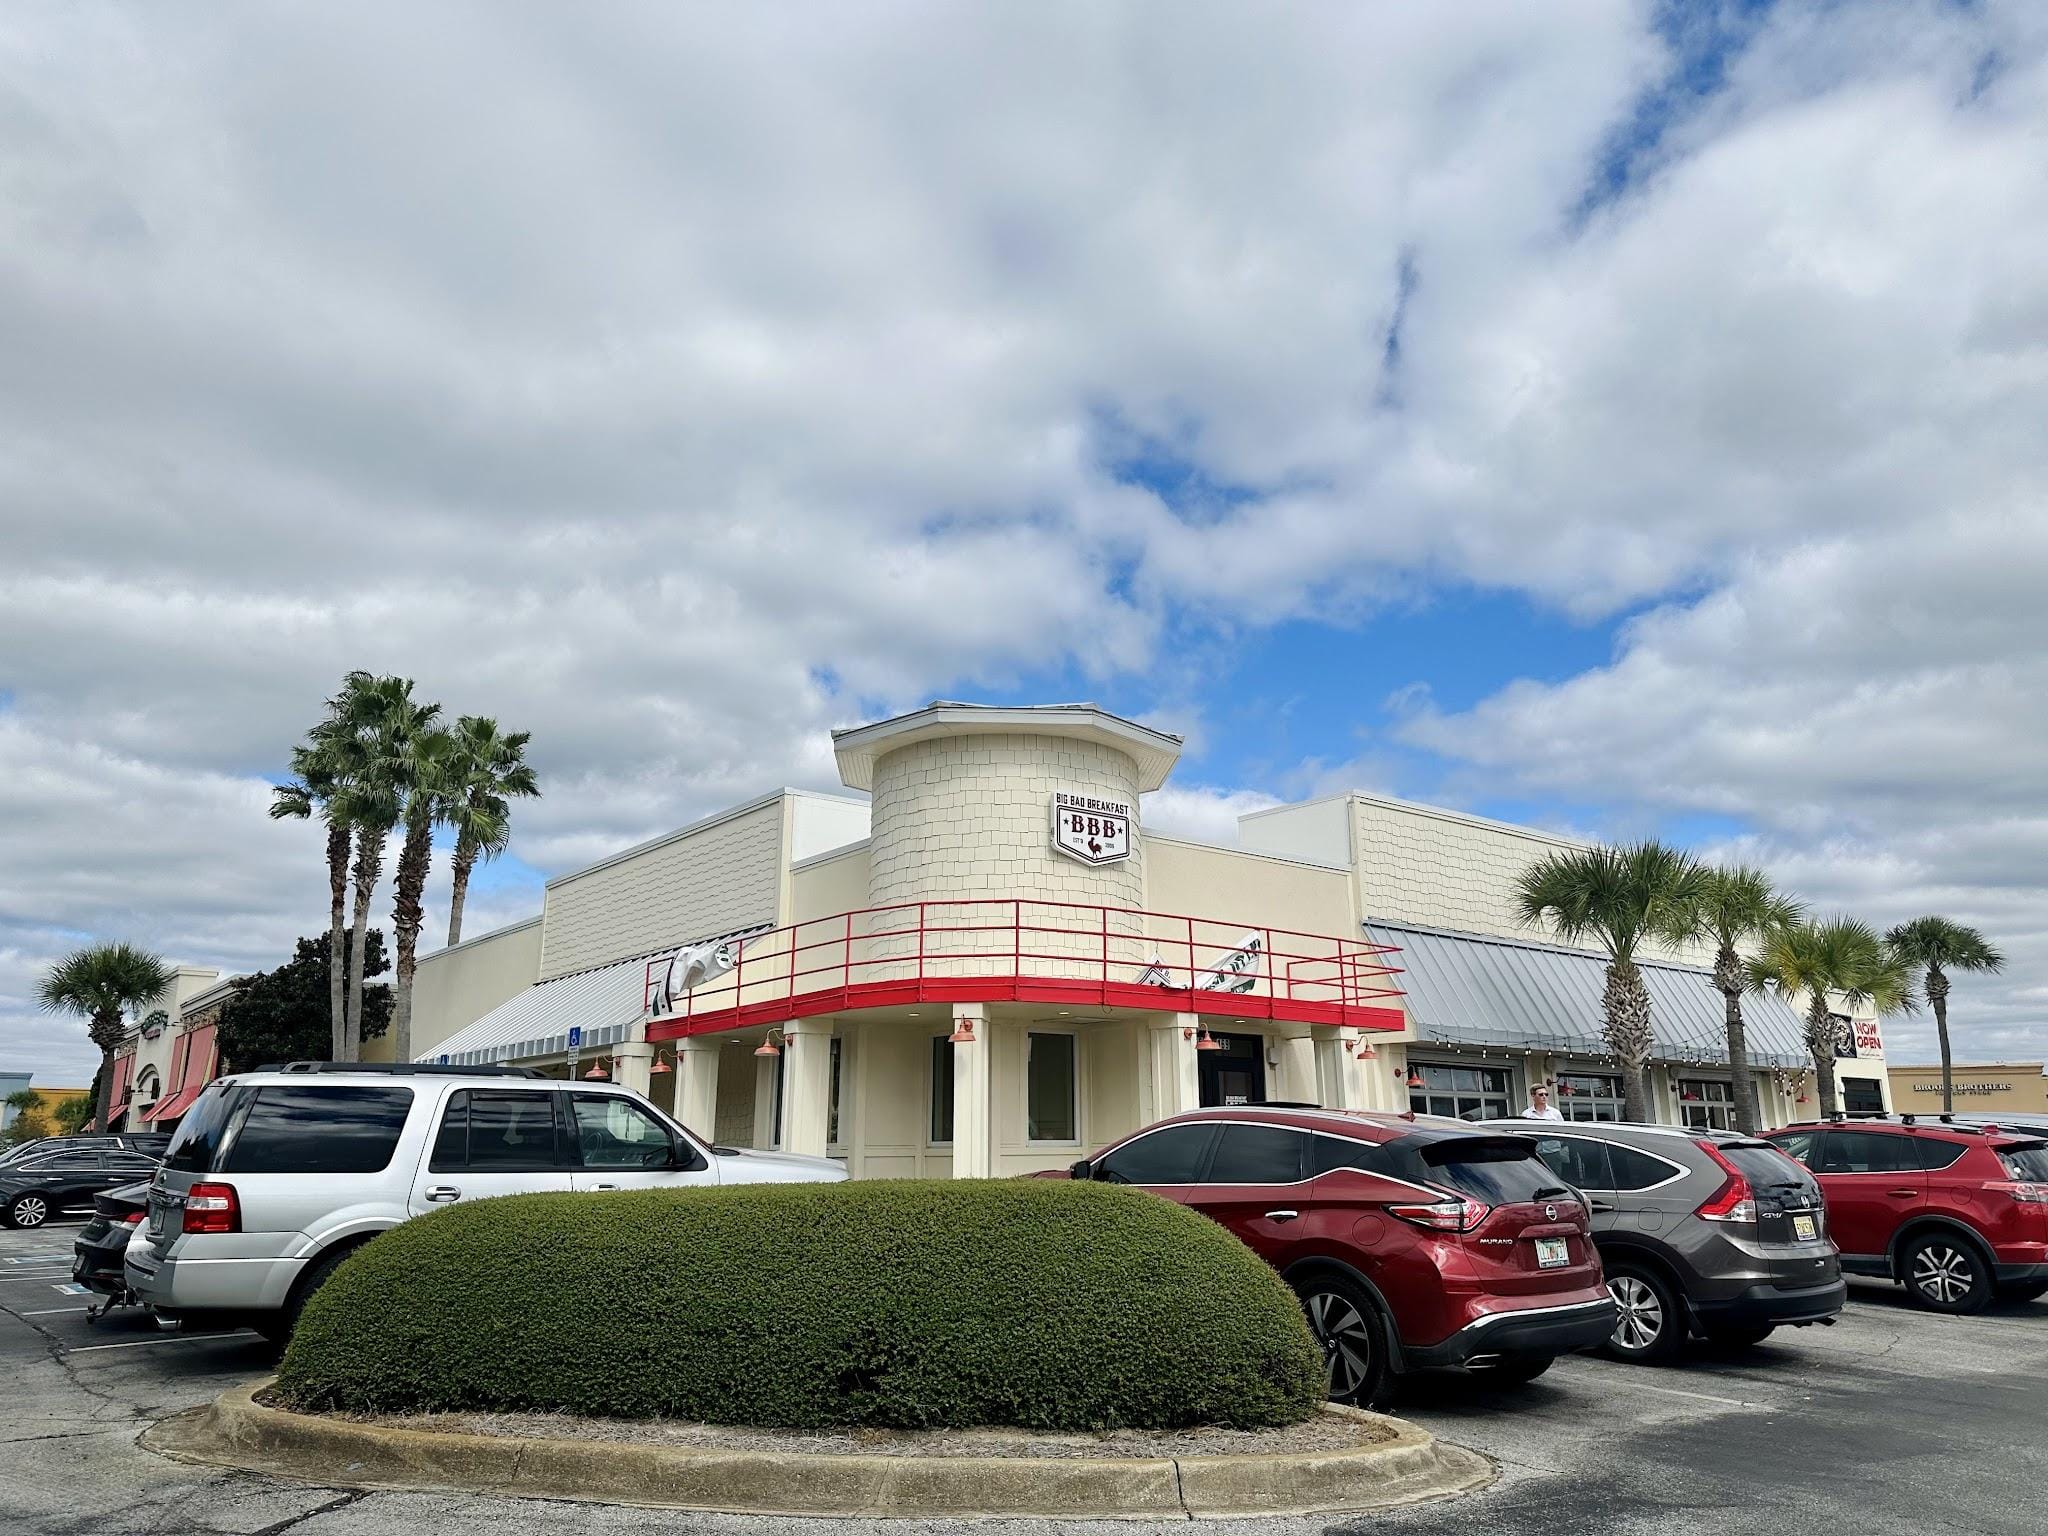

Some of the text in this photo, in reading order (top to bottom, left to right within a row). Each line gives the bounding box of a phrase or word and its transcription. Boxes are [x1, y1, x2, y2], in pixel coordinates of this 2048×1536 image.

[1056, 792, 1129, 816] BIG BAD BREAKFAST
[1071, 814, 1116, 838] BBB
[1854, 1022, 1877, 1035] NOW
[1856, 1036, 1882, 1049] OPEN
[1913, 1082, 2013, 1092] BROO BROTHERS
